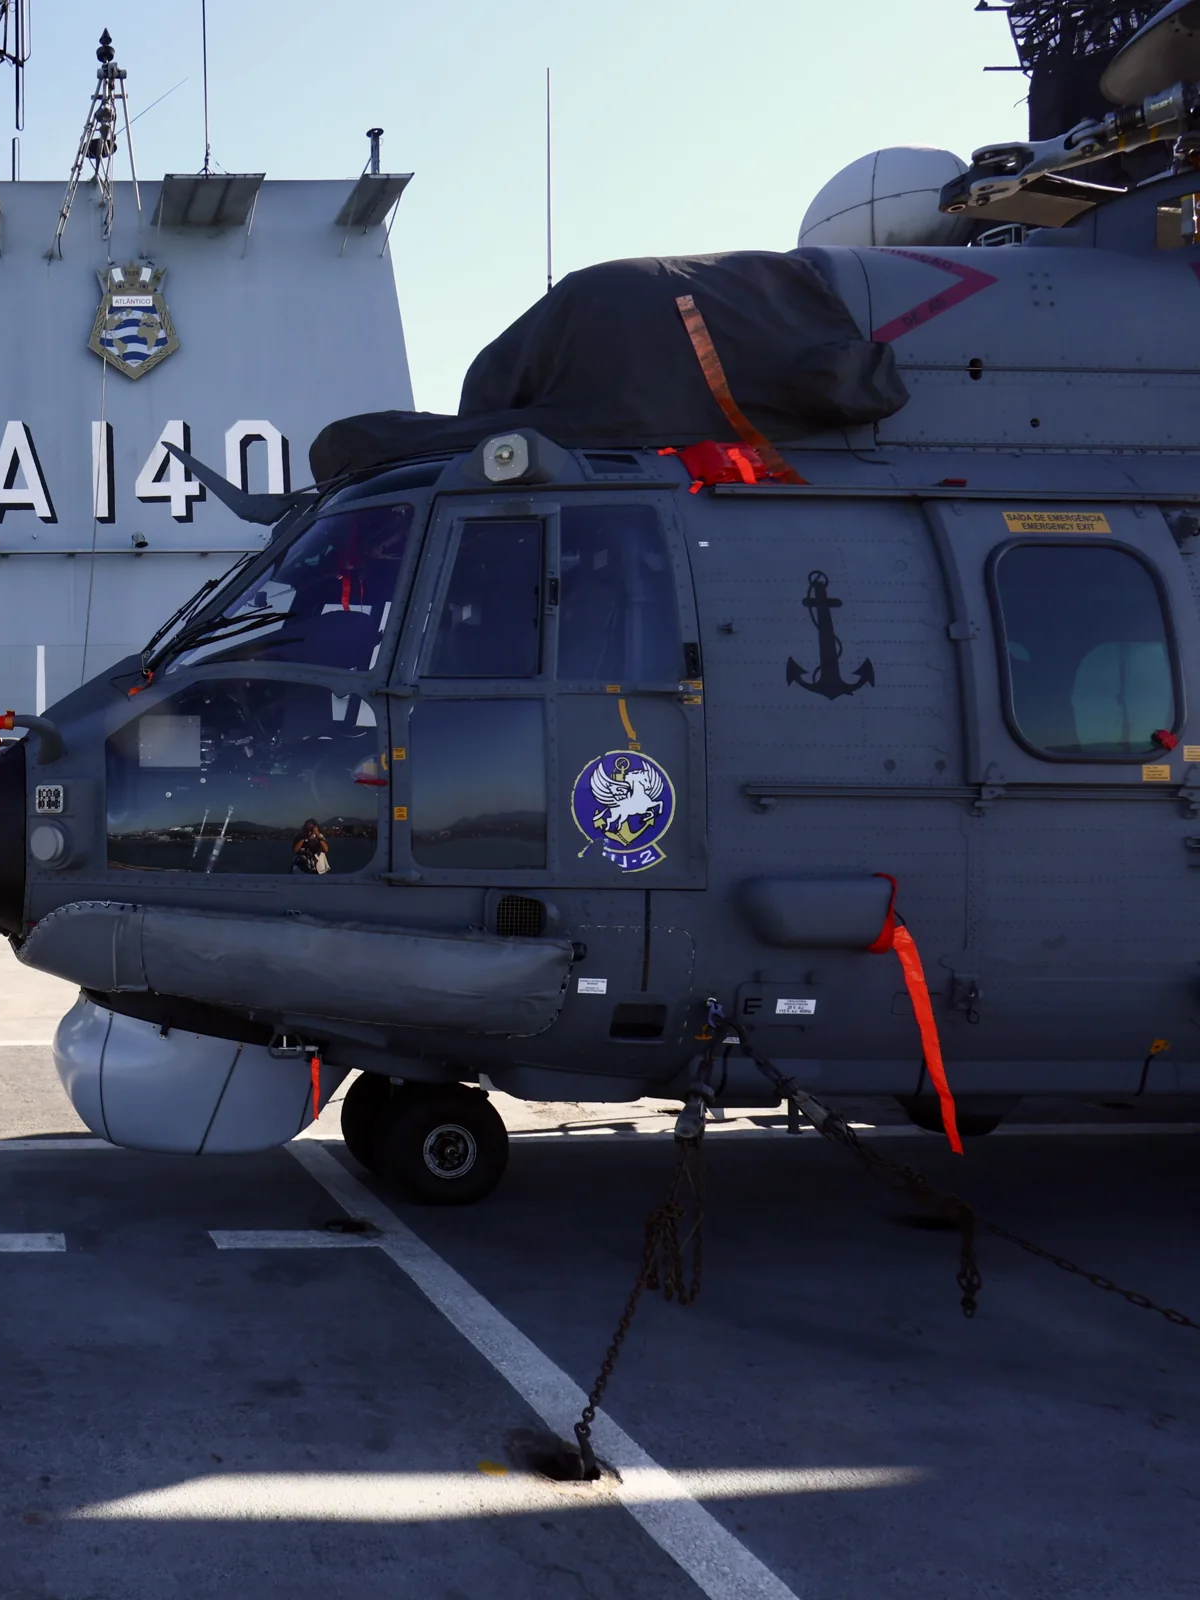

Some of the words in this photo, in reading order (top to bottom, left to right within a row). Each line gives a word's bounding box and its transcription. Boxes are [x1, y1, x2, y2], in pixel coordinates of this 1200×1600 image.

[902, 310, 920, 328] DE
[1006, 513, 1032, 521] SAÍDA
[1034, 514, 1045, 522] DE
[1048, 513, 1104, 522] EMERGÊNCIA
[1022, 522, 1074, 530] EMERGENCY
